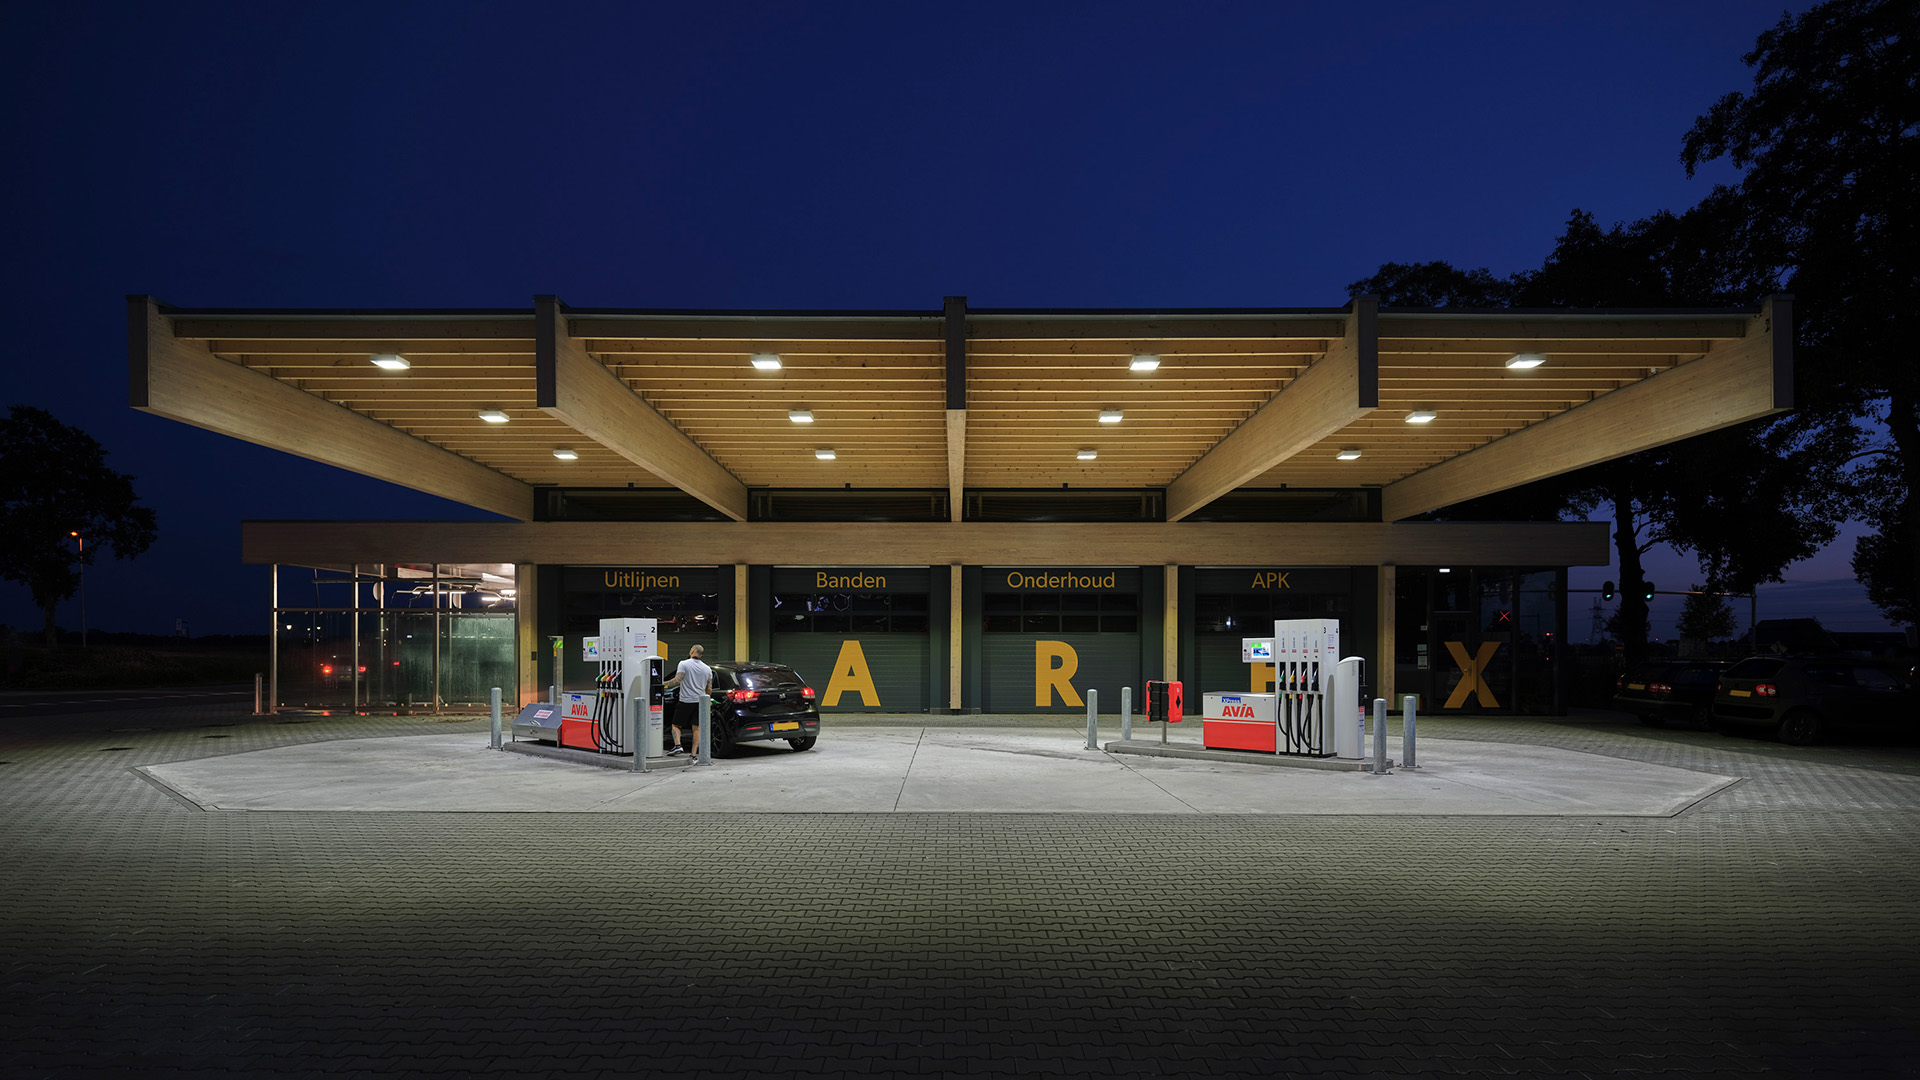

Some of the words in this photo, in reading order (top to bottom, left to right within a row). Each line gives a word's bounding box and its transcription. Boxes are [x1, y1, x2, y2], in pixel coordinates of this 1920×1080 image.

[605, 571, 680, 591] Uitlijnen
[816, 571, 886, 589] Banden
[1007, 571, 1115, 589] Onderhoud
[1251, 572, 1290, 589] APK
[821, 640, 881, 706] A
[1035, 640, 1085, 706] R
[1443, 641, 1501, 708] X
[1222, 703, 1255, 718] AVIA
